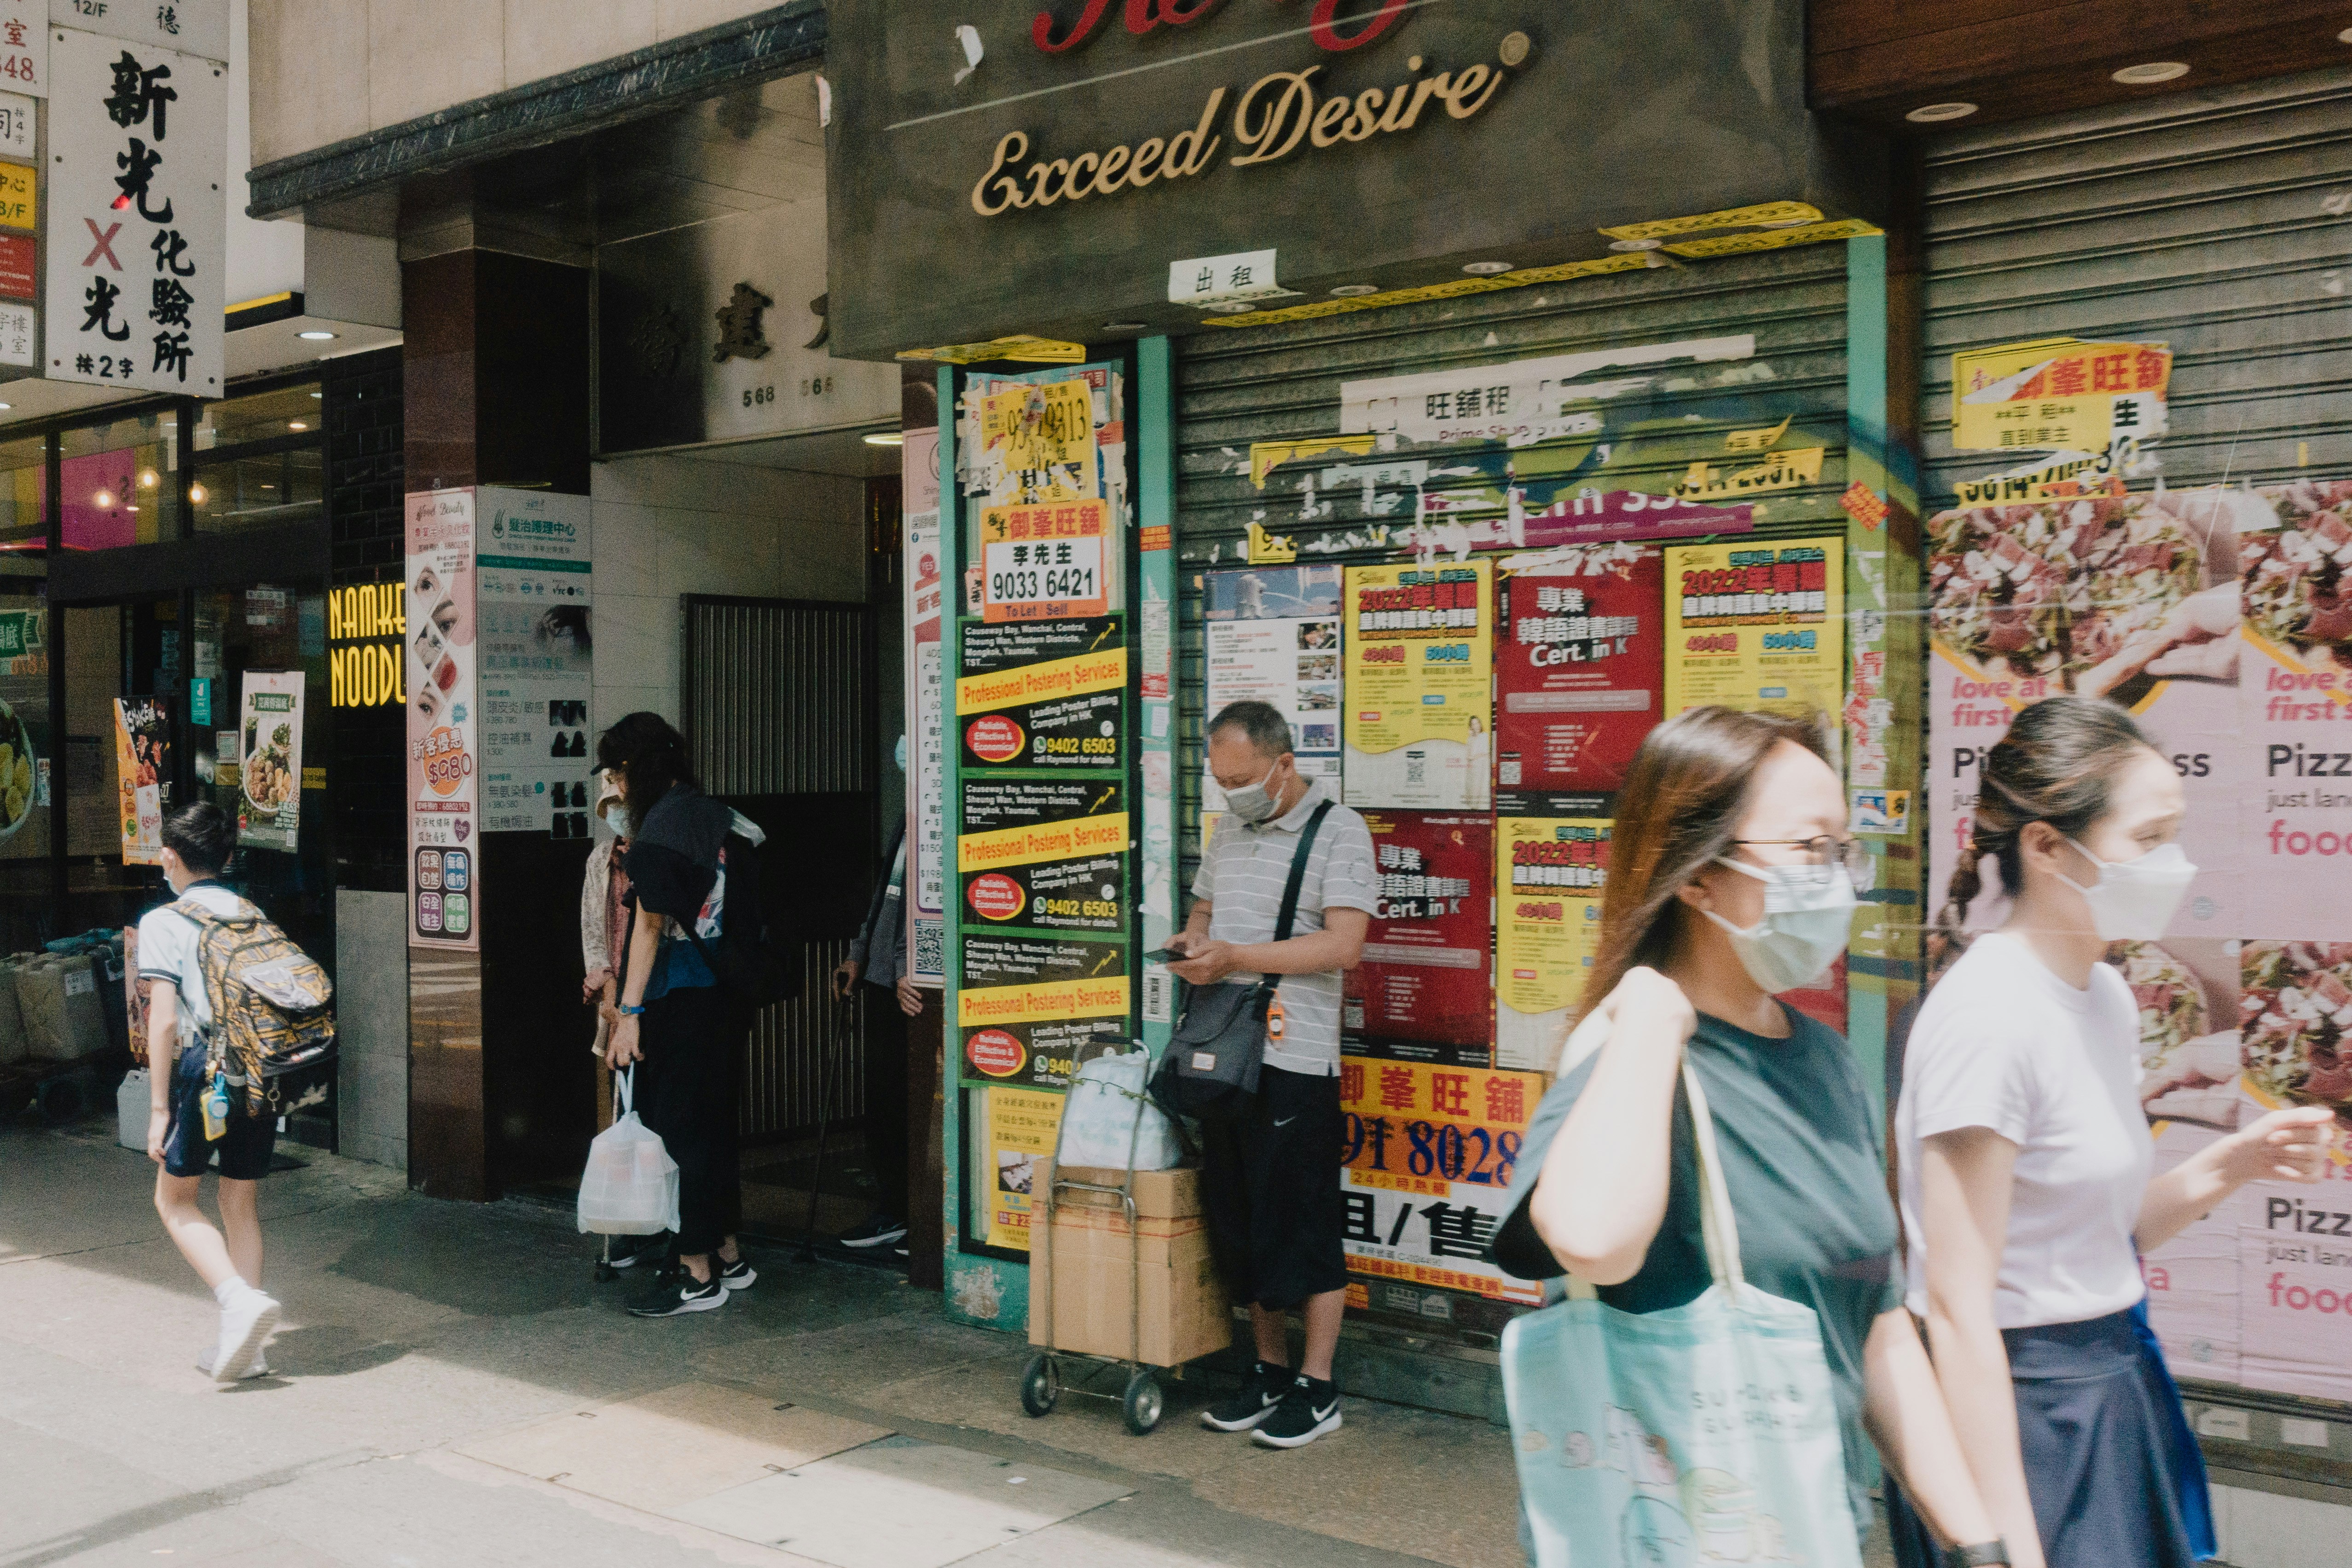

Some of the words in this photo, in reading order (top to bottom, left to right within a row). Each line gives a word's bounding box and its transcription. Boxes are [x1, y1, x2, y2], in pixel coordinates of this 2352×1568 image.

[4, 18, 28, 47] 室
[0, 54, 35, 82] 48
[1231, 54, 1504, 168] Desire
[972, 87, 1225, 216] Exceed
[104, 50, 178, 224] 新光
[149, 229, 196, 382] 化驗所
[1195, 265, 1253, 294] 出租
[742, 386, 775, 408] 568
[2114, 399, 2139, 427] 生
[1013, 542, 1072, 567] 李先生
[993, 571, 1038, 600] 9033
[1046, 567, 1093, 597] 6421
[1006, 605, 1019, 617] To
[1020, 604, 1037, 617] Let
[1046, 603, 1068, 615] Sell
[1536, 586, 1585, 613] 專業
[1529, 644, 1587, 667] Cert.
[1592, 640, 1610, 660] in
[964, 676, 1024, 705] Professional
[1026, 668, 1072, 691] Postering
[1074, 660, 1120, 683] Services
[1952, 676, 2013, 700] love
[2019, 677, 2048, 697] at
[2266, 667, 2335, 691] love
[1952, 702, 2012, 727] first
[2267, 696, 2336, 722] first
[412, 727, 463, 761] 新客優惠
[1047, 738, 1079, 754] 9402
[1082, 738, 1116, 754] 6503
[428, 752, 472, 786] $980
[2266, 792, 2309, 813] just
[964, 835, 1025, 862] Professional
[1028, 830, 1072, 853] Postering
[1074, 823, 1120, 846] Services
[1379, 844, 1422, 871] 專業
[1046, 899, 1080, 915] 9402
[1083, 900, 1118, 917] 6503
[1376, 899, 1424, 920] Cert.
[1428, 898, 1445, 917] in
[964, 993, 1025, 1017] Professional
[1025, 990, 1076, 1014] Postering
[1077, 986, 1122, 1007] Services
[2265, 1244, 2307, 1266] just
